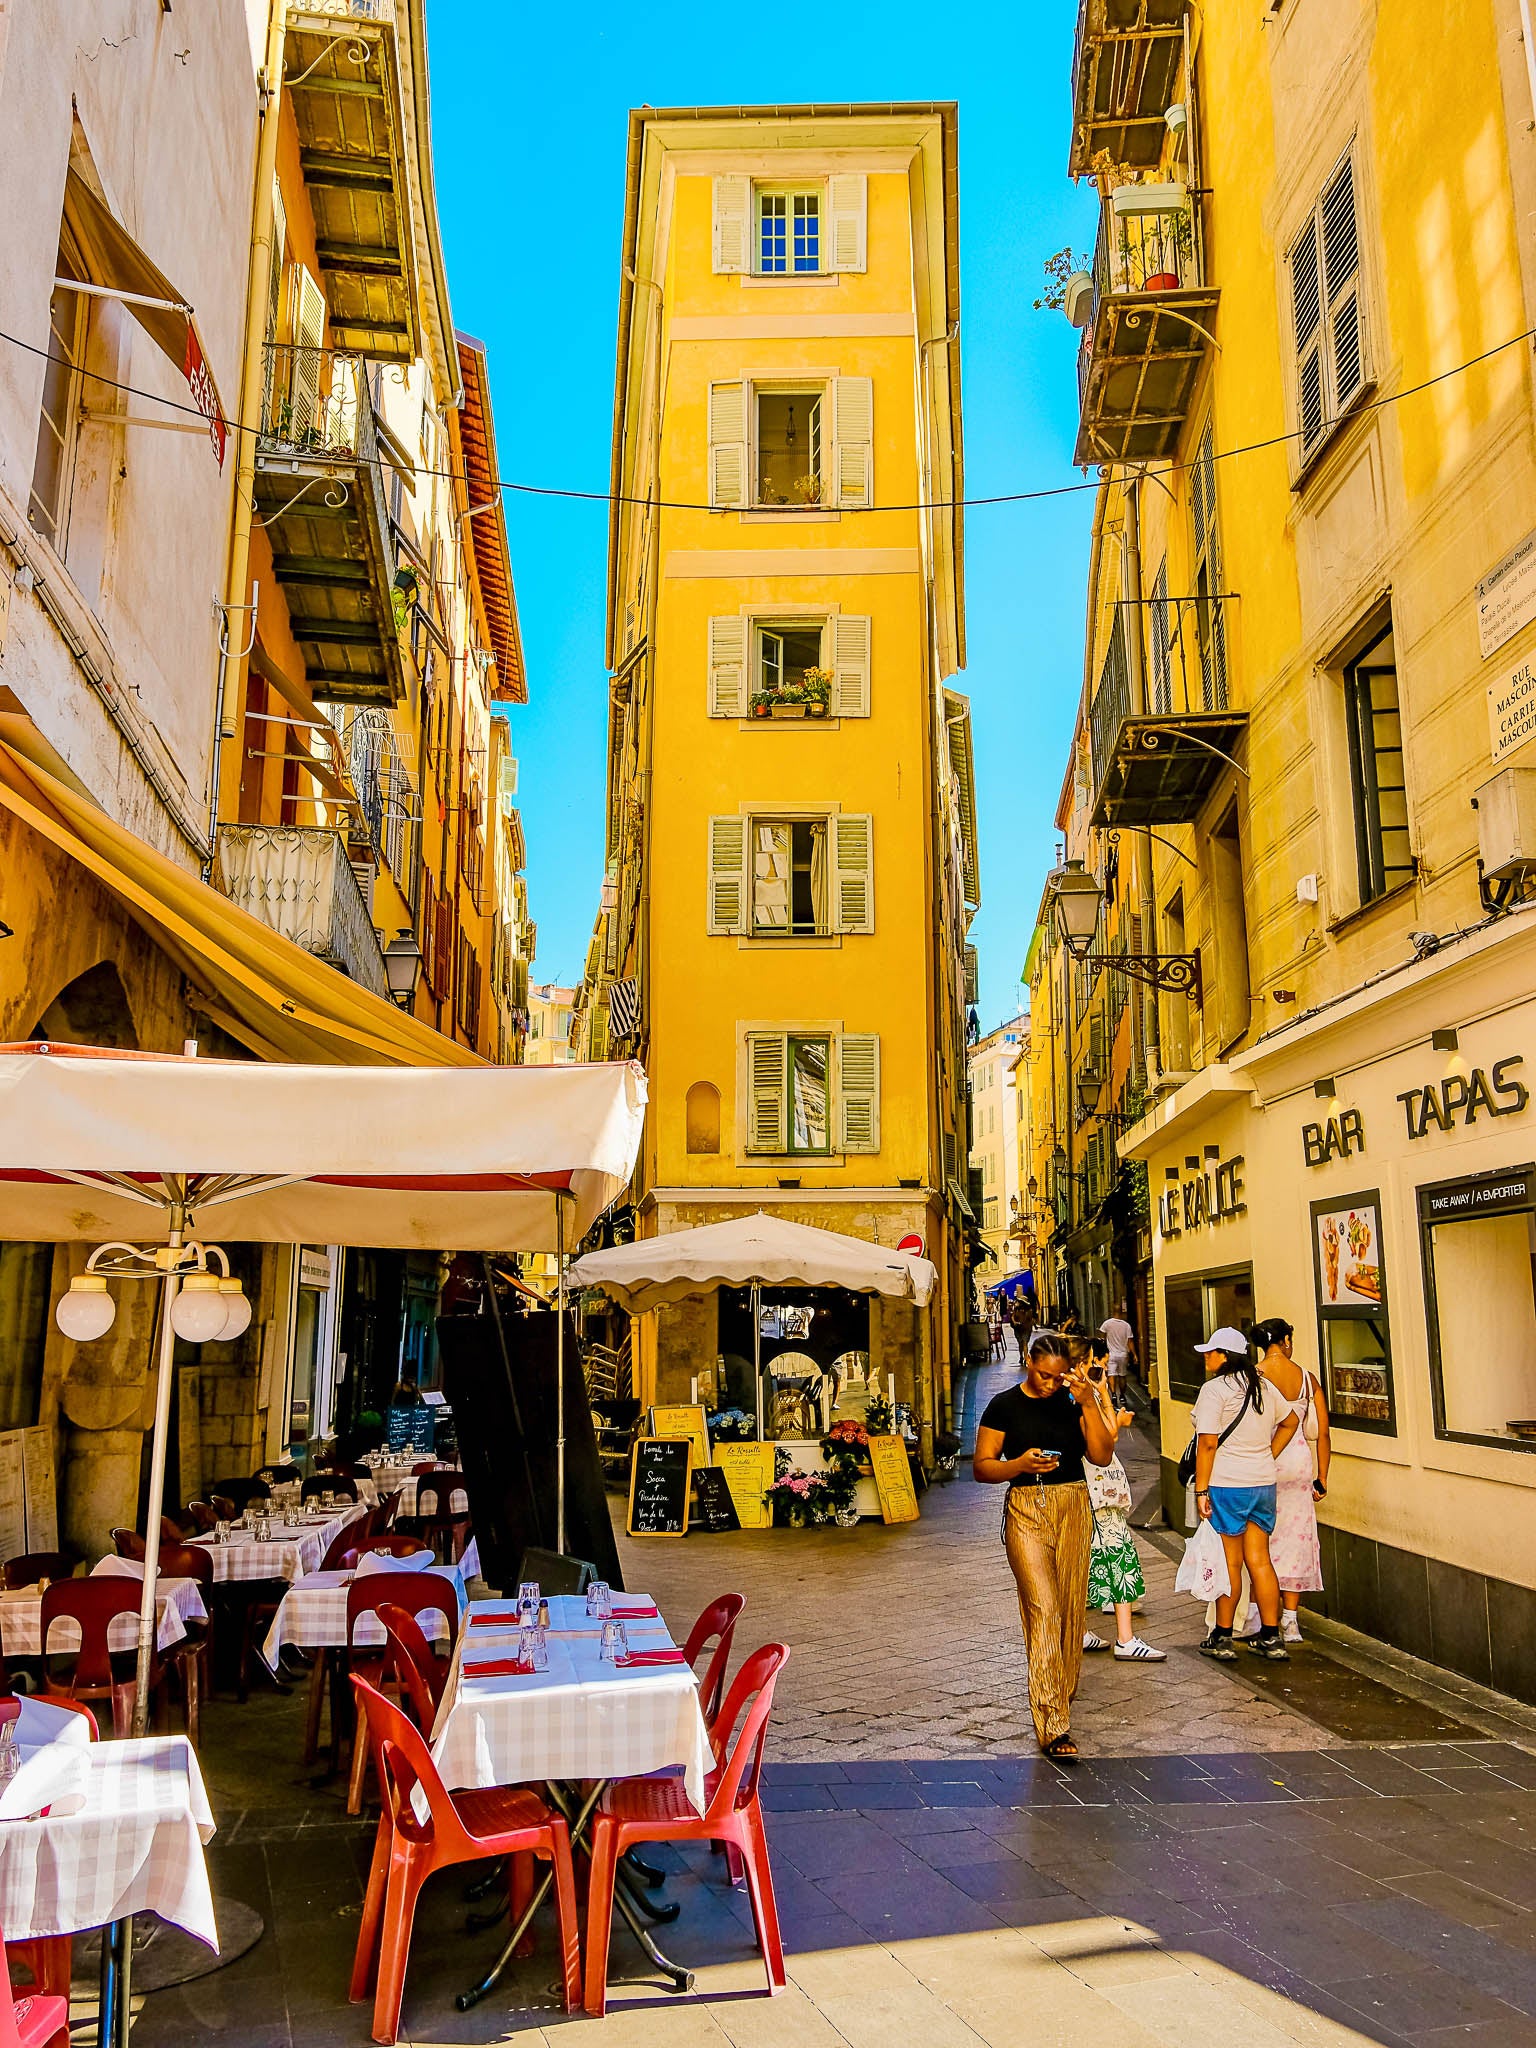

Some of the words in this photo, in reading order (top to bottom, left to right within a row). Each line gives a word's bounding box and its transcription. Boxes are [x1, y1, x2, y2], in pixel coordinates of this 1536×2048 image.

[1511, 664, 1531, 688] RUE
[1500, 699, 1536, 733] CARRIE
[1302, 1108, 1365, 1168] BAR
[1396, 1055, 1530, 1140] TAPAS
[1431, 1196, 1449, 1210] TAKE
[1449, 1192, 1470, 1207] AWAY
[1471, 1189, 1475, 1205] /
[1476, 1191, 1483, 1203] A
[1483, 1183, 1526, 1201] EMPORTER
[1158, 1188, 1182, 1238] LE
[646, 1470, 666, 1484] Socca
